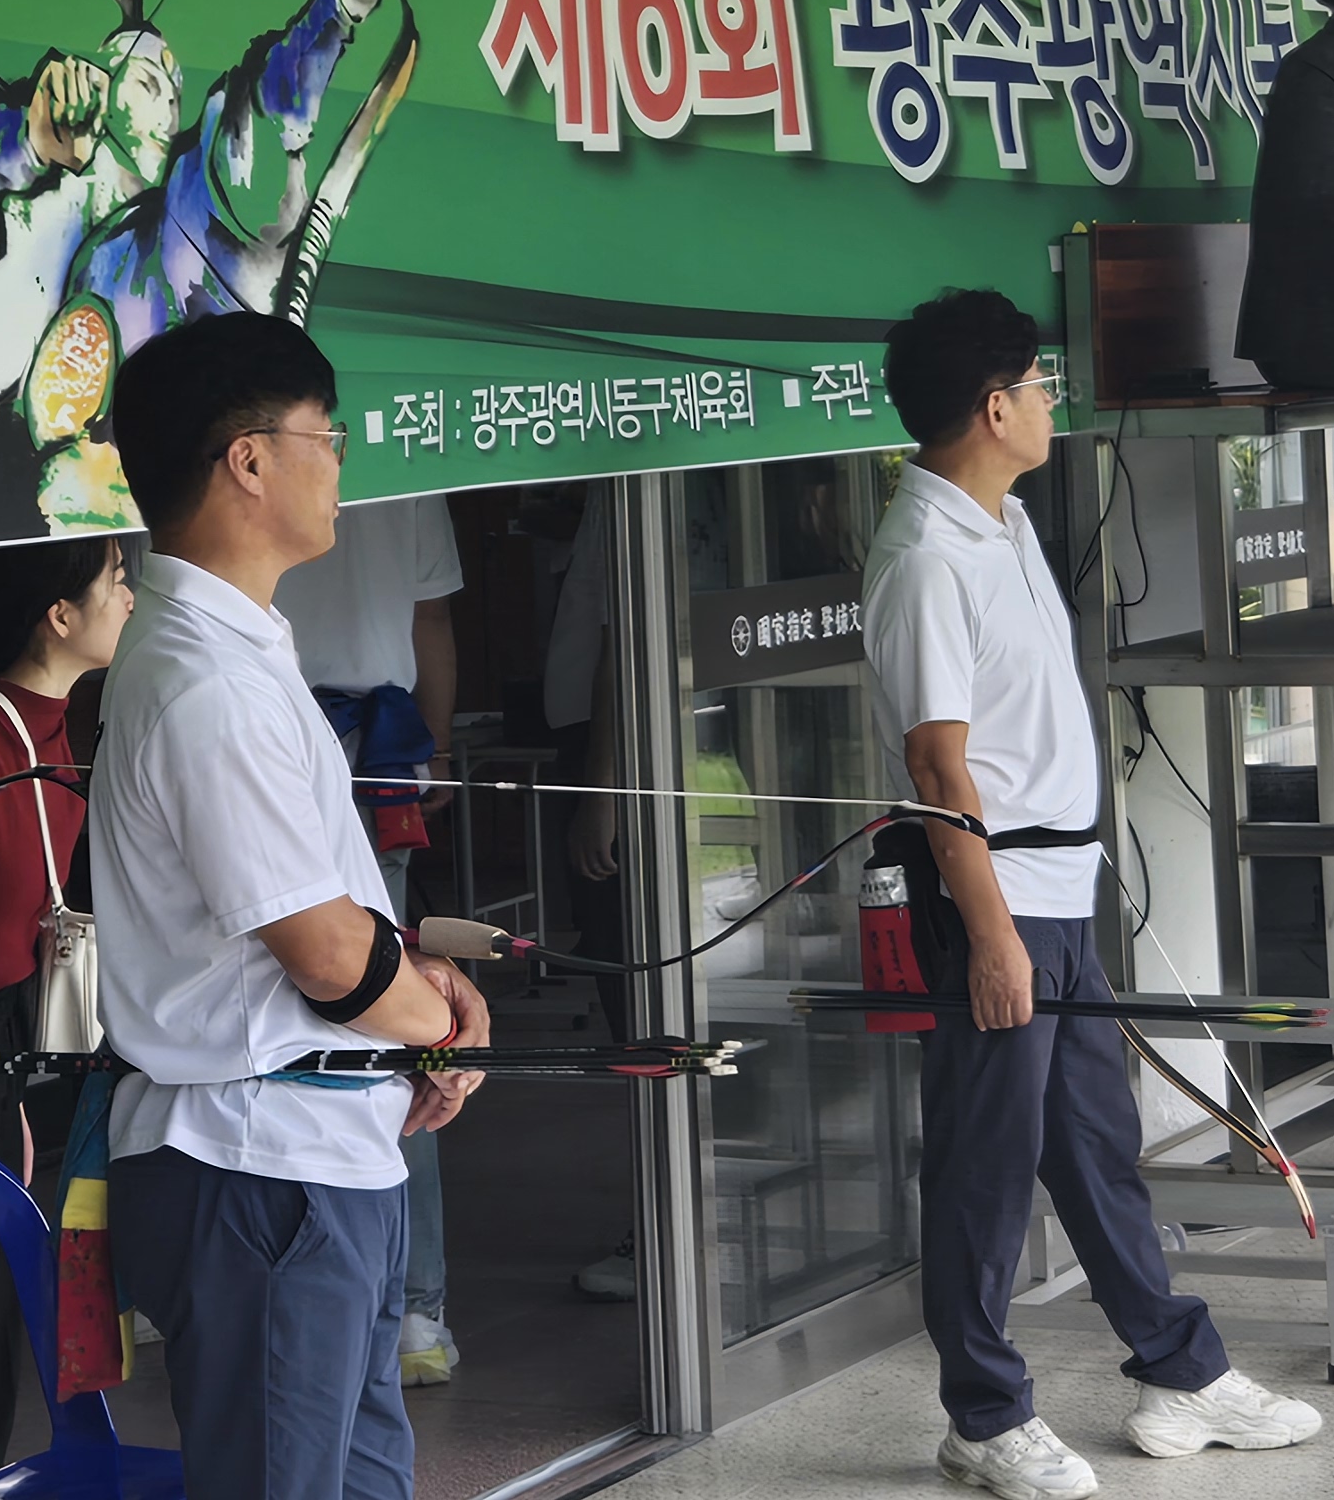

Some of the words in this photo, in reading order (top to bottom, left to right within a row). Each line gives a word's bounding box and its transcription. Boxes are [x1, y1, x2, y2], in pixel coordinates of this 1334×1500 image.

[392, 389, 444, 458] 주최
[470, 368, 755, 451] 광주광역시동구체육회
[810, 359, 873, 421] 주관
